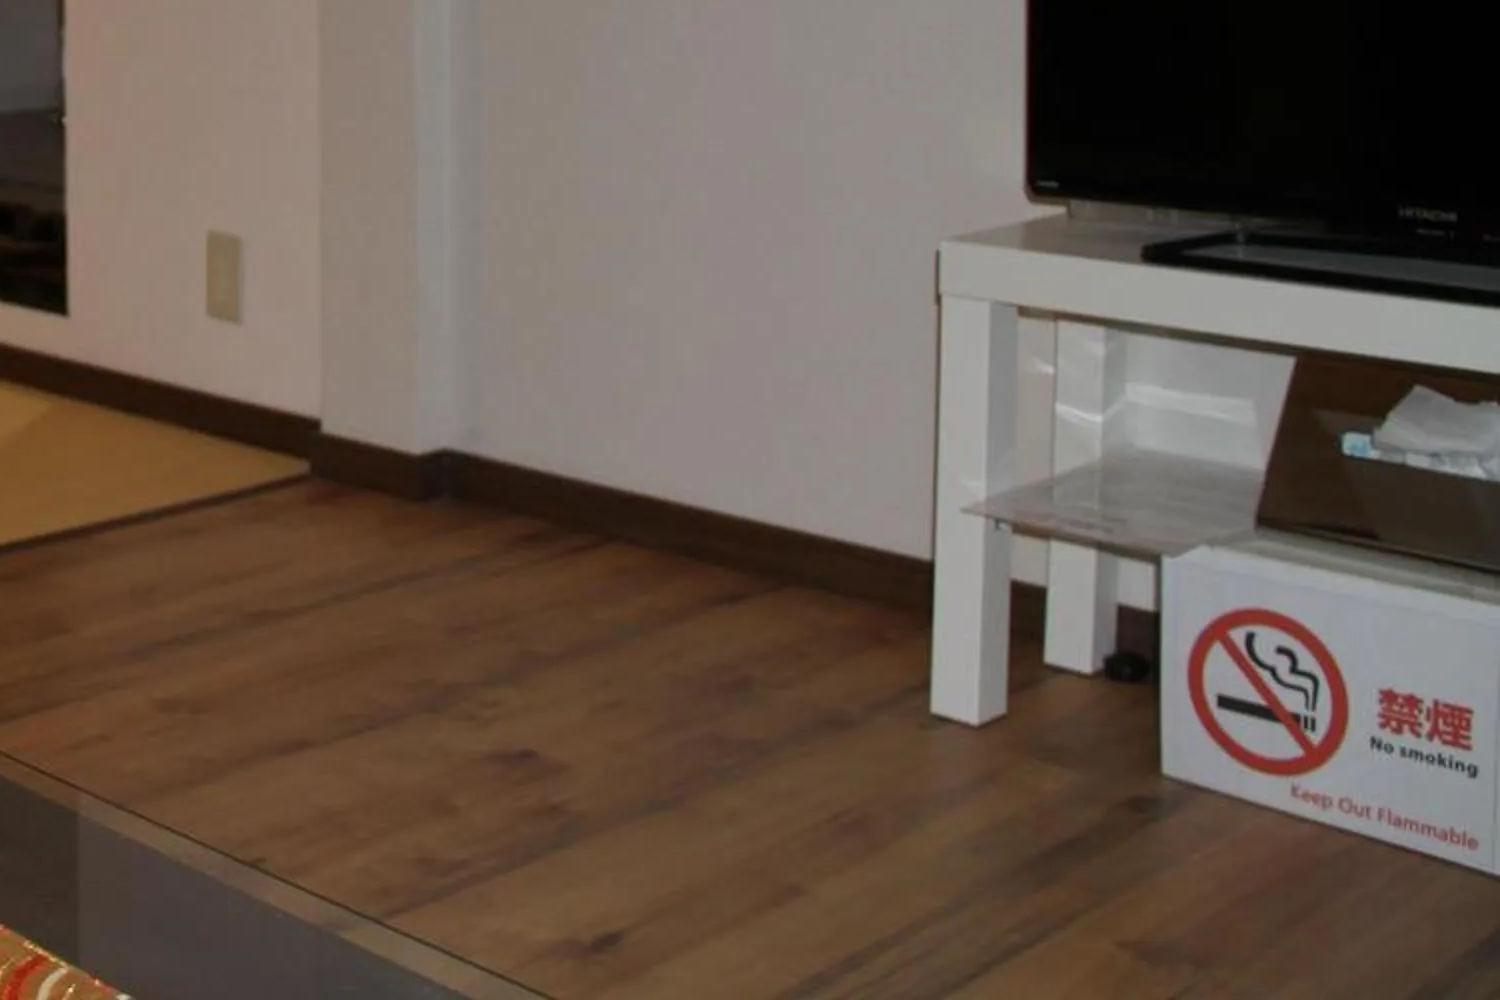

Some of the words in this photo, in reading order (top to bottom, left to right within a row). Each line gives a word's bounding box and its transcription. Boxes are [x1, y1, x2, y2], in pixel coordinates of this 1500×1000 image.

[1377, 687, 1474, 751] 禁煙
[1370, 736, 1395, 755] No
[1400, 744, 1480, 778] smoking
[1290, 783, 1334, 810] Keep
[1339, 797, 1372, 821] Out
[1377, 807, 1480, 851] Flammable
